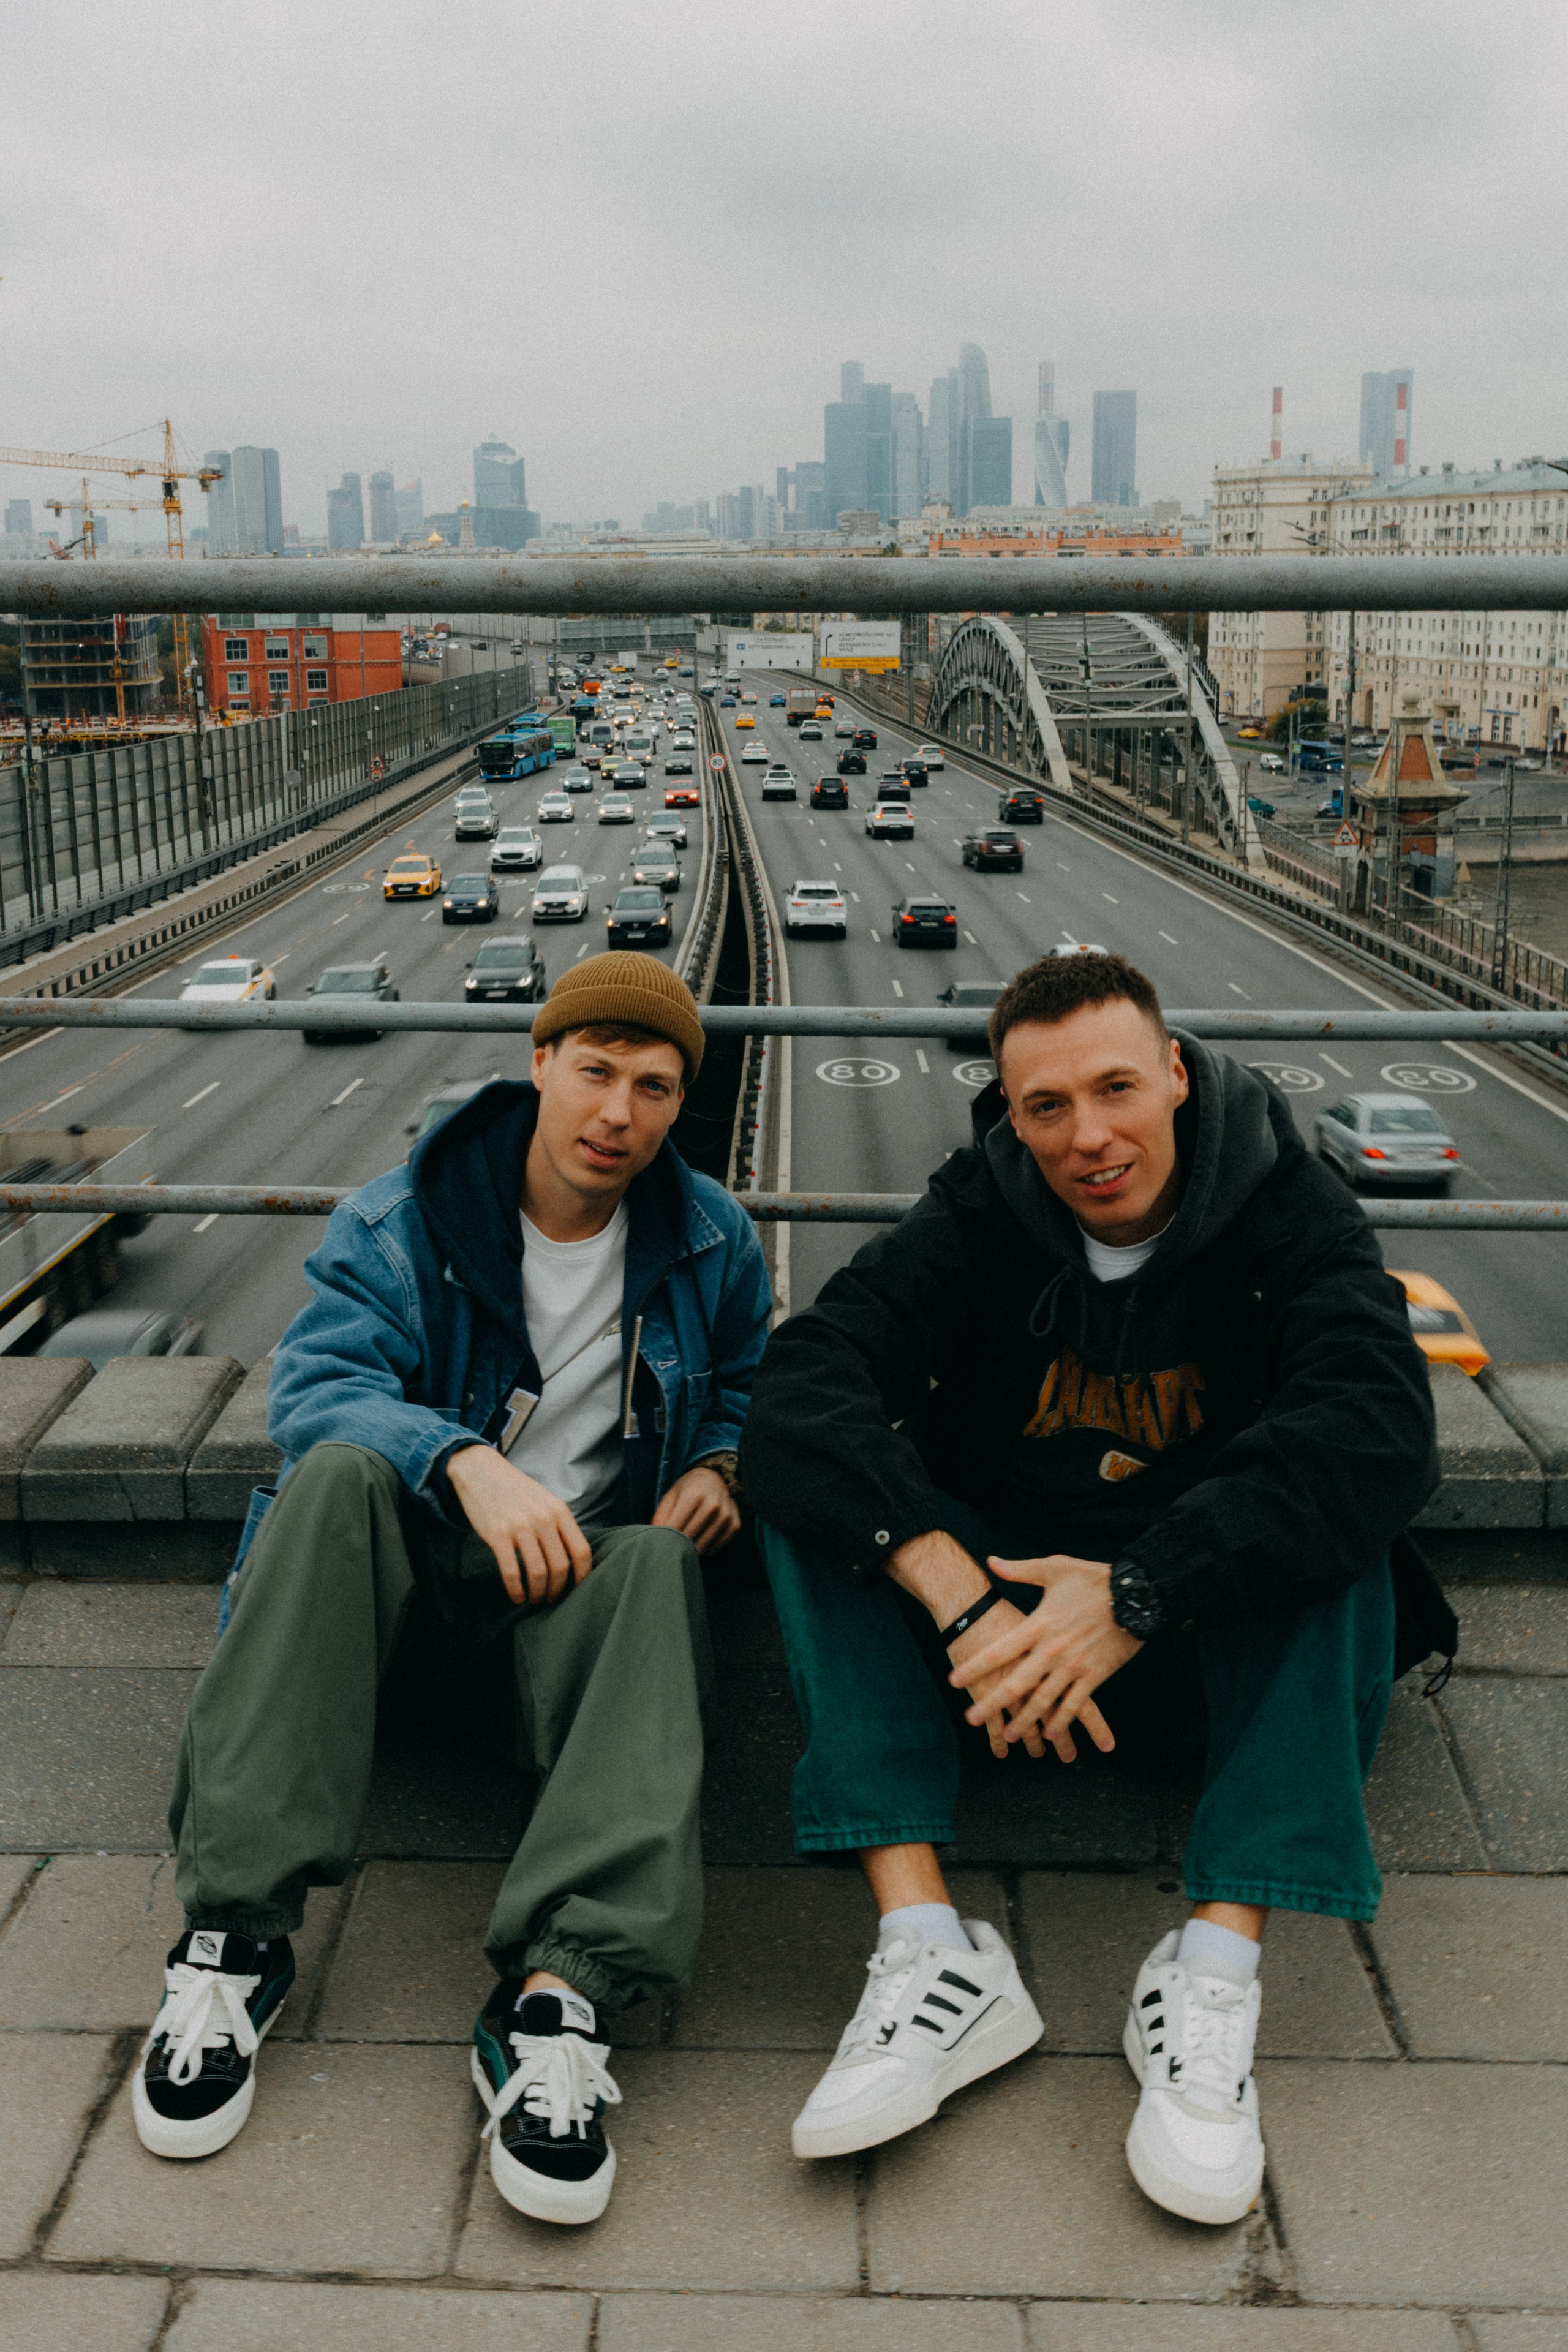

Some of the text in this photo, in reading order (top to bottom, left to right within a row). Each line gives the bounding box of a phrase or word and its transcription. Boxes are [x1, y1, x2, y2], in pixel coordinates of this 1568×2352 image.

[831, 1065, 886, 1079] 80
[968, 1067, 993, 1081] 8
[1396, 1070, 1460, 1085] 80
